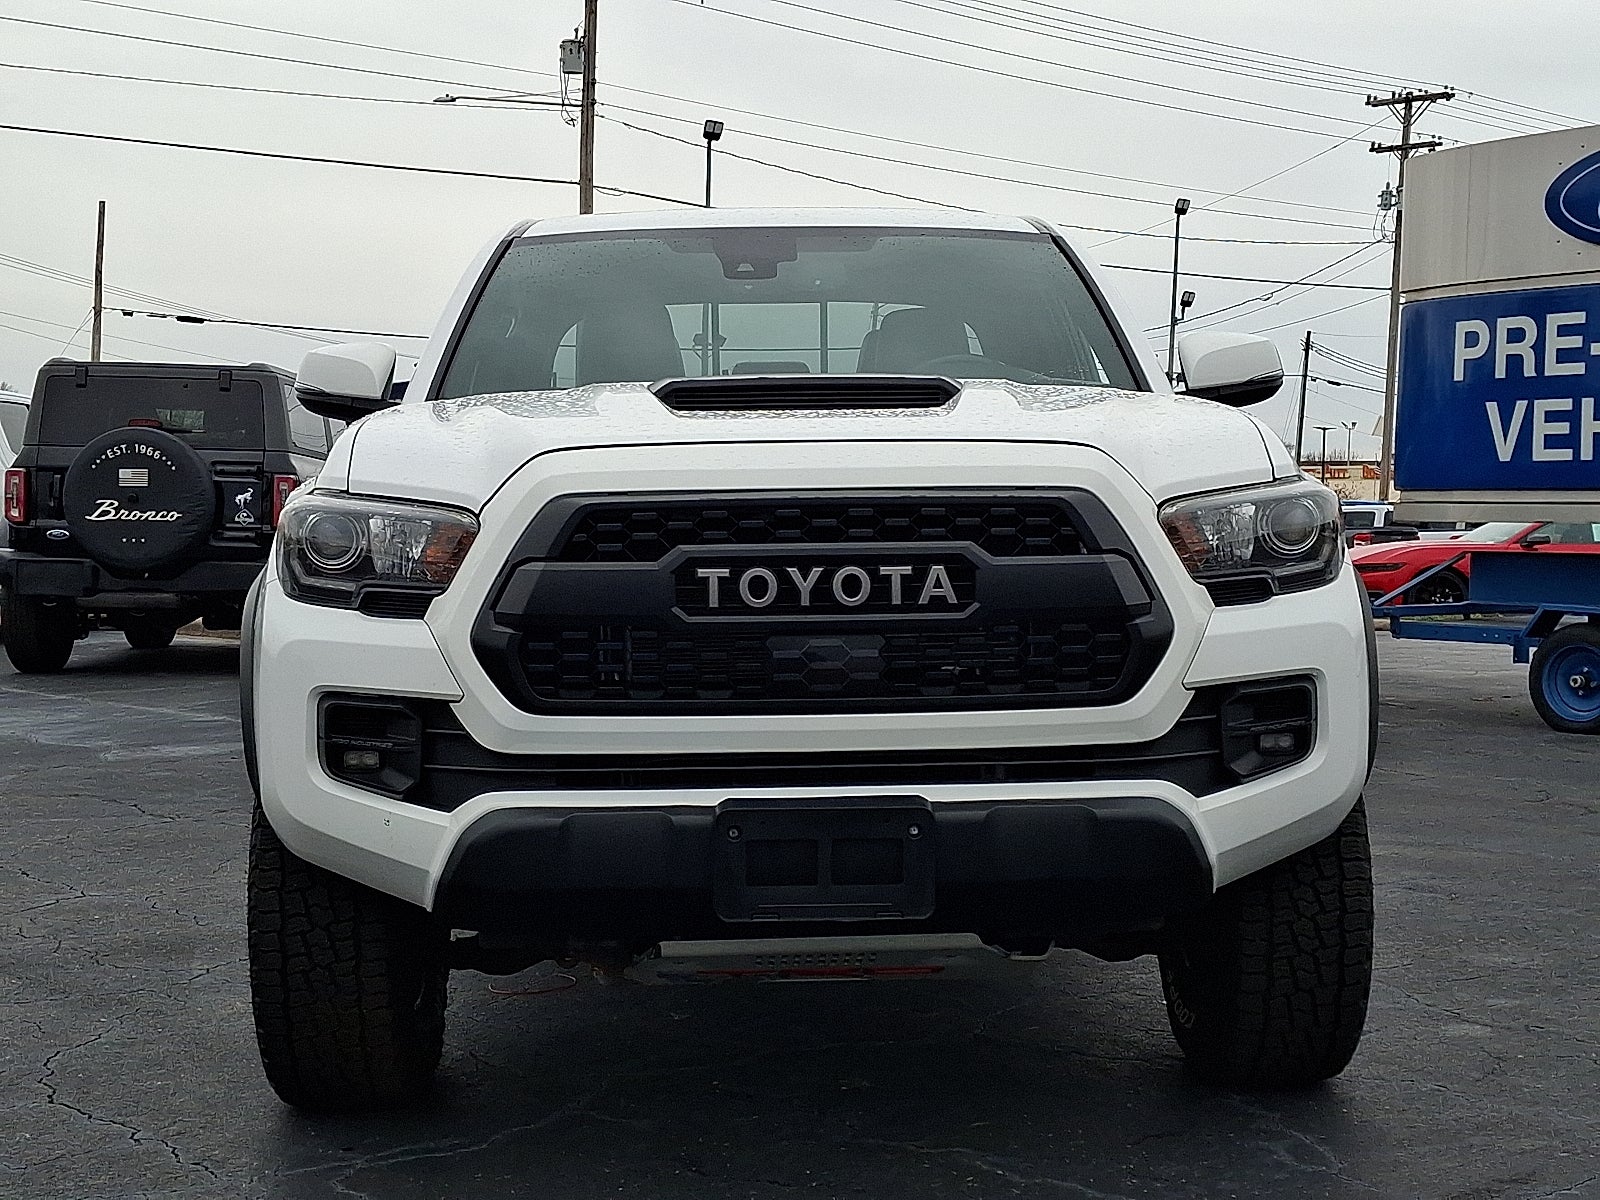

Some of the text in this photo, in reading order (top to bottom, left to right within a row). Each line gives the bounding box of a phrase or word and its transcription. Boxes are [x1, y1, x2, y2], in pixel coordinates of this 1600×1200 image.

[1453, 311, 1600, 381] PRE-
[106, 443, 161, 459] EST. 1966
[84, 499, 183, 521] Bronco
[696, 565, 958, 608] TOYOTA
